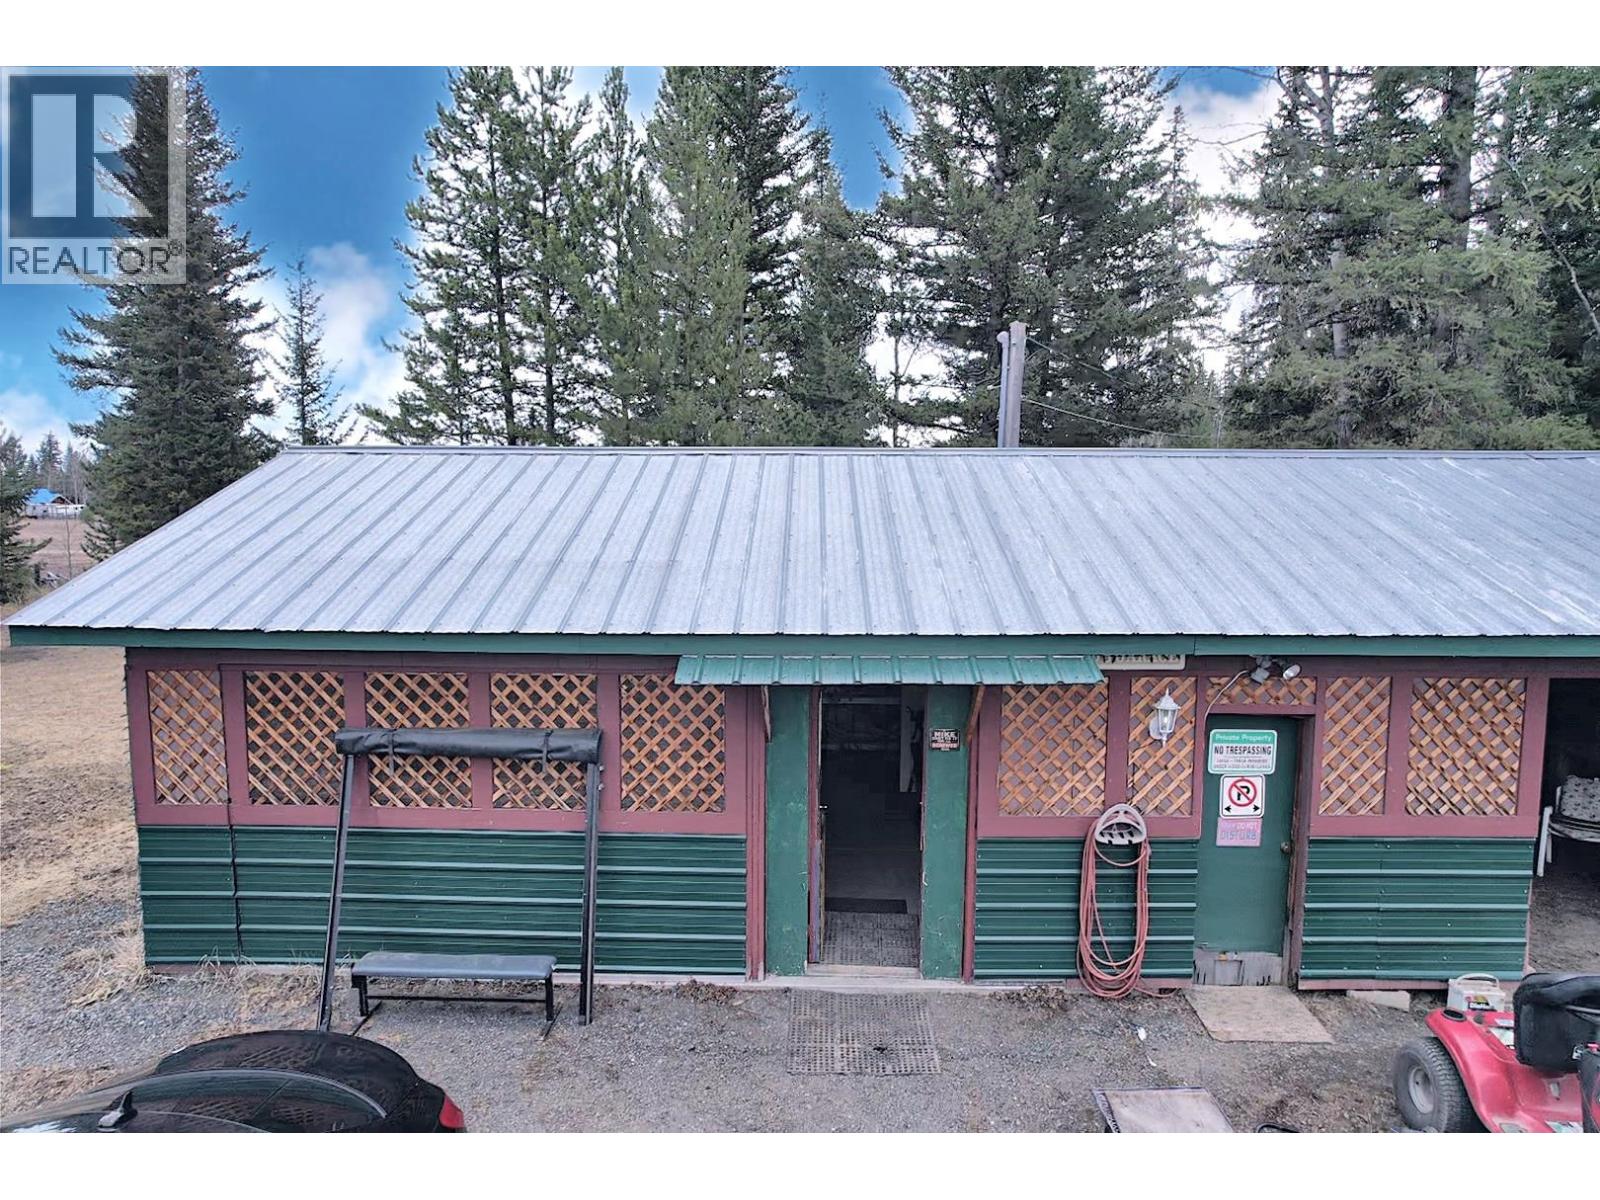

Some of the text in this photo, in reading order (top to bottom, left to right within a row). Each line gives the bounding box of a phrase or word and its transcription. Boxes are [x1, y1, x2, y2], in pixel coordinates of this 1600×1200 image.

[1215, 733, 1272, 742] Private Property
[1214, 745, 1272, 755] NO TRESPASSING
[1220, 831, 1257, 841] DISTURB
